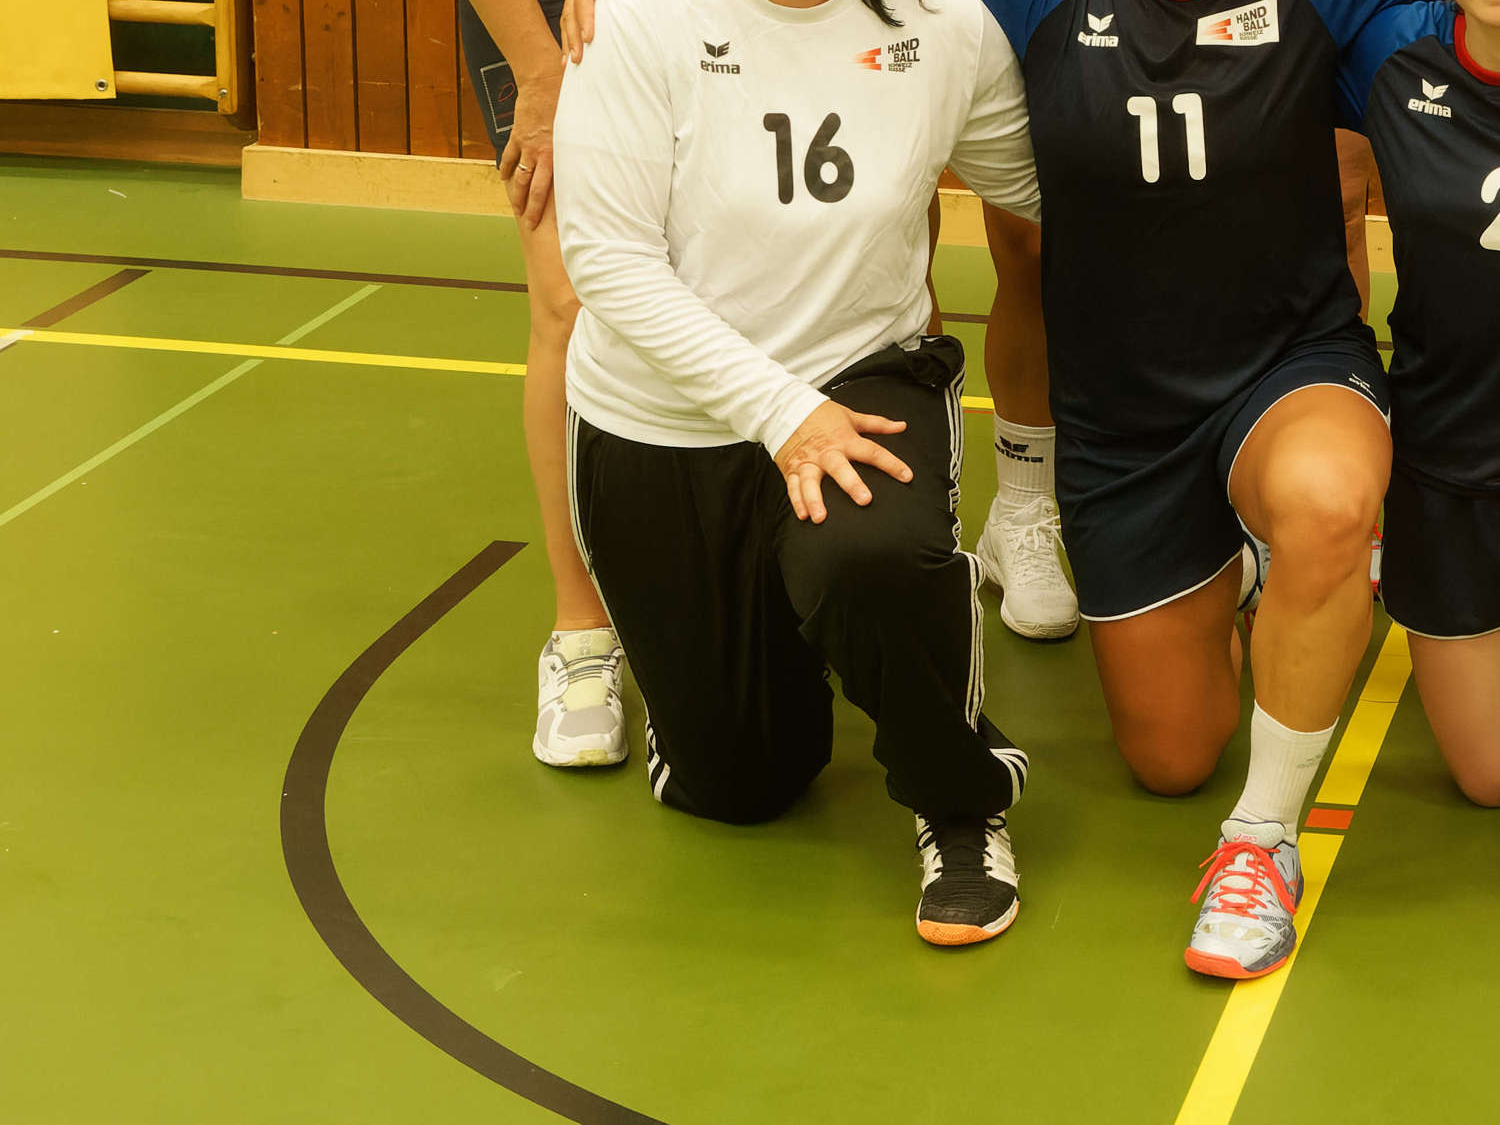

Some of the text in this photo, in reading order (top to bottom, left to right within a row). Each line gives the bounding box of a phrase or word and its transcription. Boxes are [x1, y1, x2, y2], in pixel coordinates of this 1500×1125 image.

[1235, 6, 1267, 24] HAND
[1243, 18, 1270, 32] BALL
[887, 38, 920, 54] HAND
[1077, 31, 1119, 48] erima
[893, 50, 920, 63] BALL
[700, 60, 741, 75] erima
[1407, 98, 1452, 118] erima
[1127, 92, 1207, 184] 11
[763, 112, 855, 205] 16
